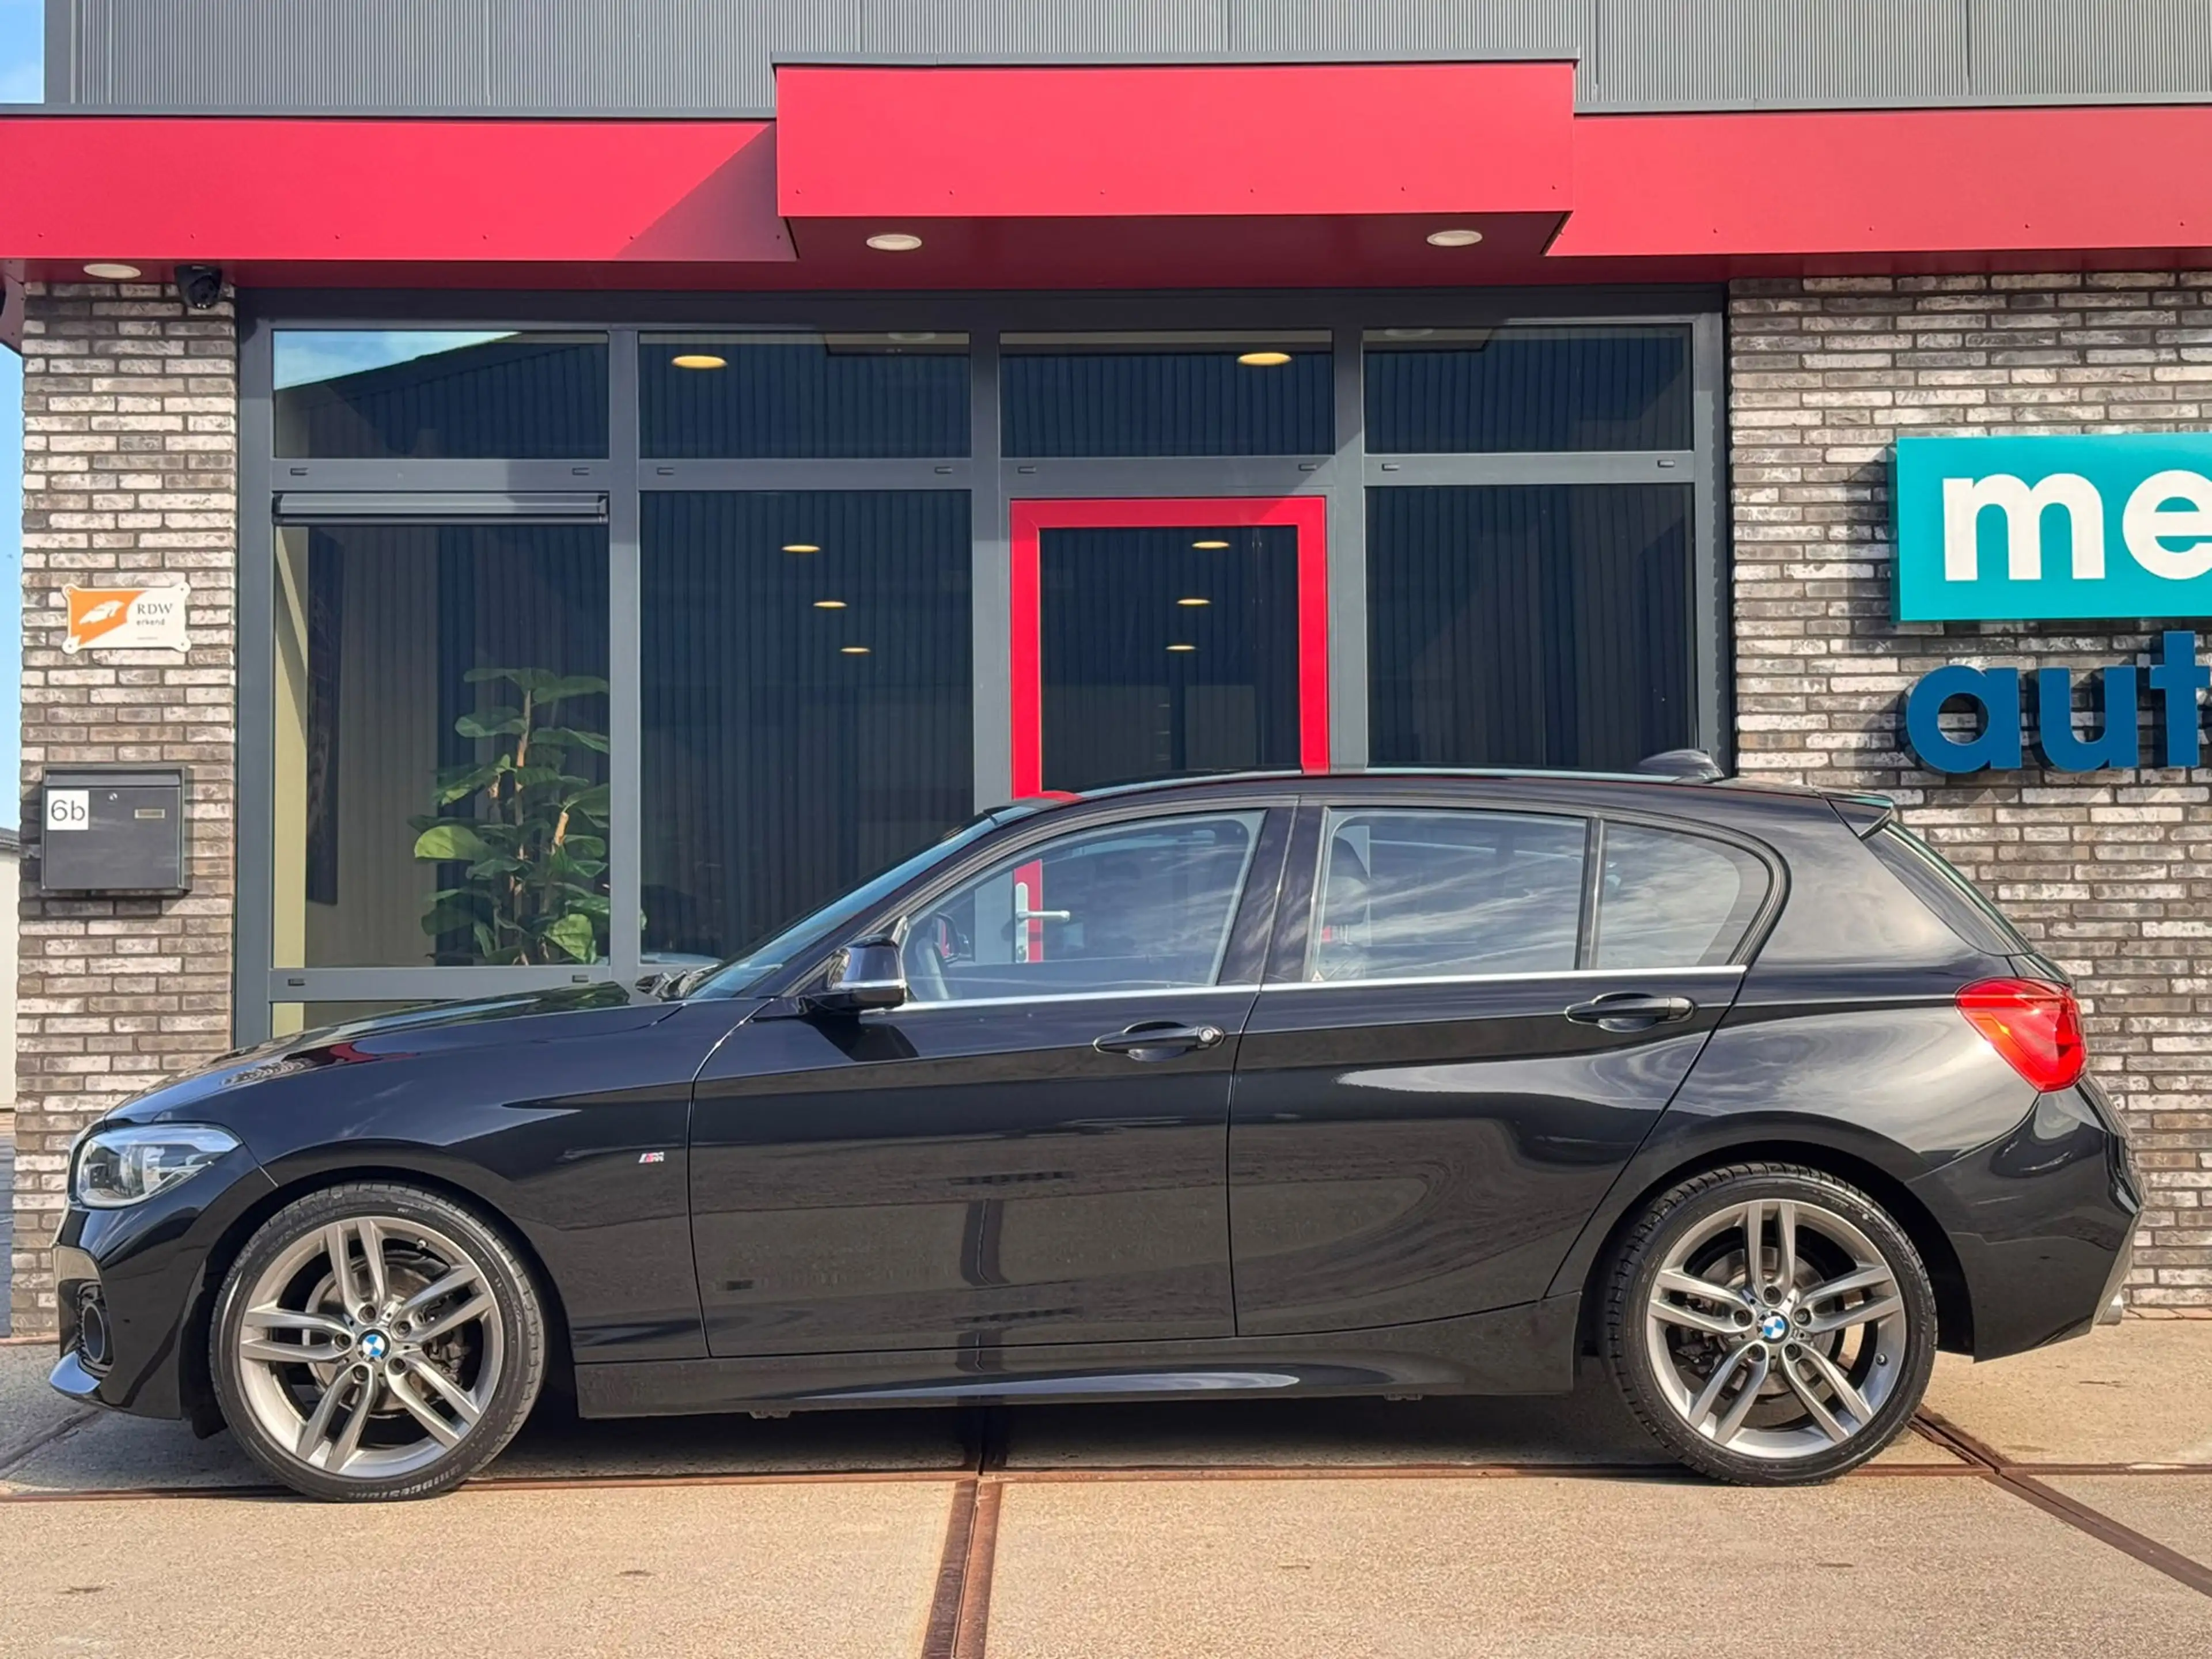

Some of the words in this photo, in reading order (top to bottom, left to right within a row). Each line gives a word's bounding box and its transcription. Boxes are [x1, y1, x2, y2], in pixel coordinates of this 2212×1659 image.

[137, 603, 173, 615] RDW
[137, 618, 165, 626] erkend
[51, 800, 85, 821] 6b
